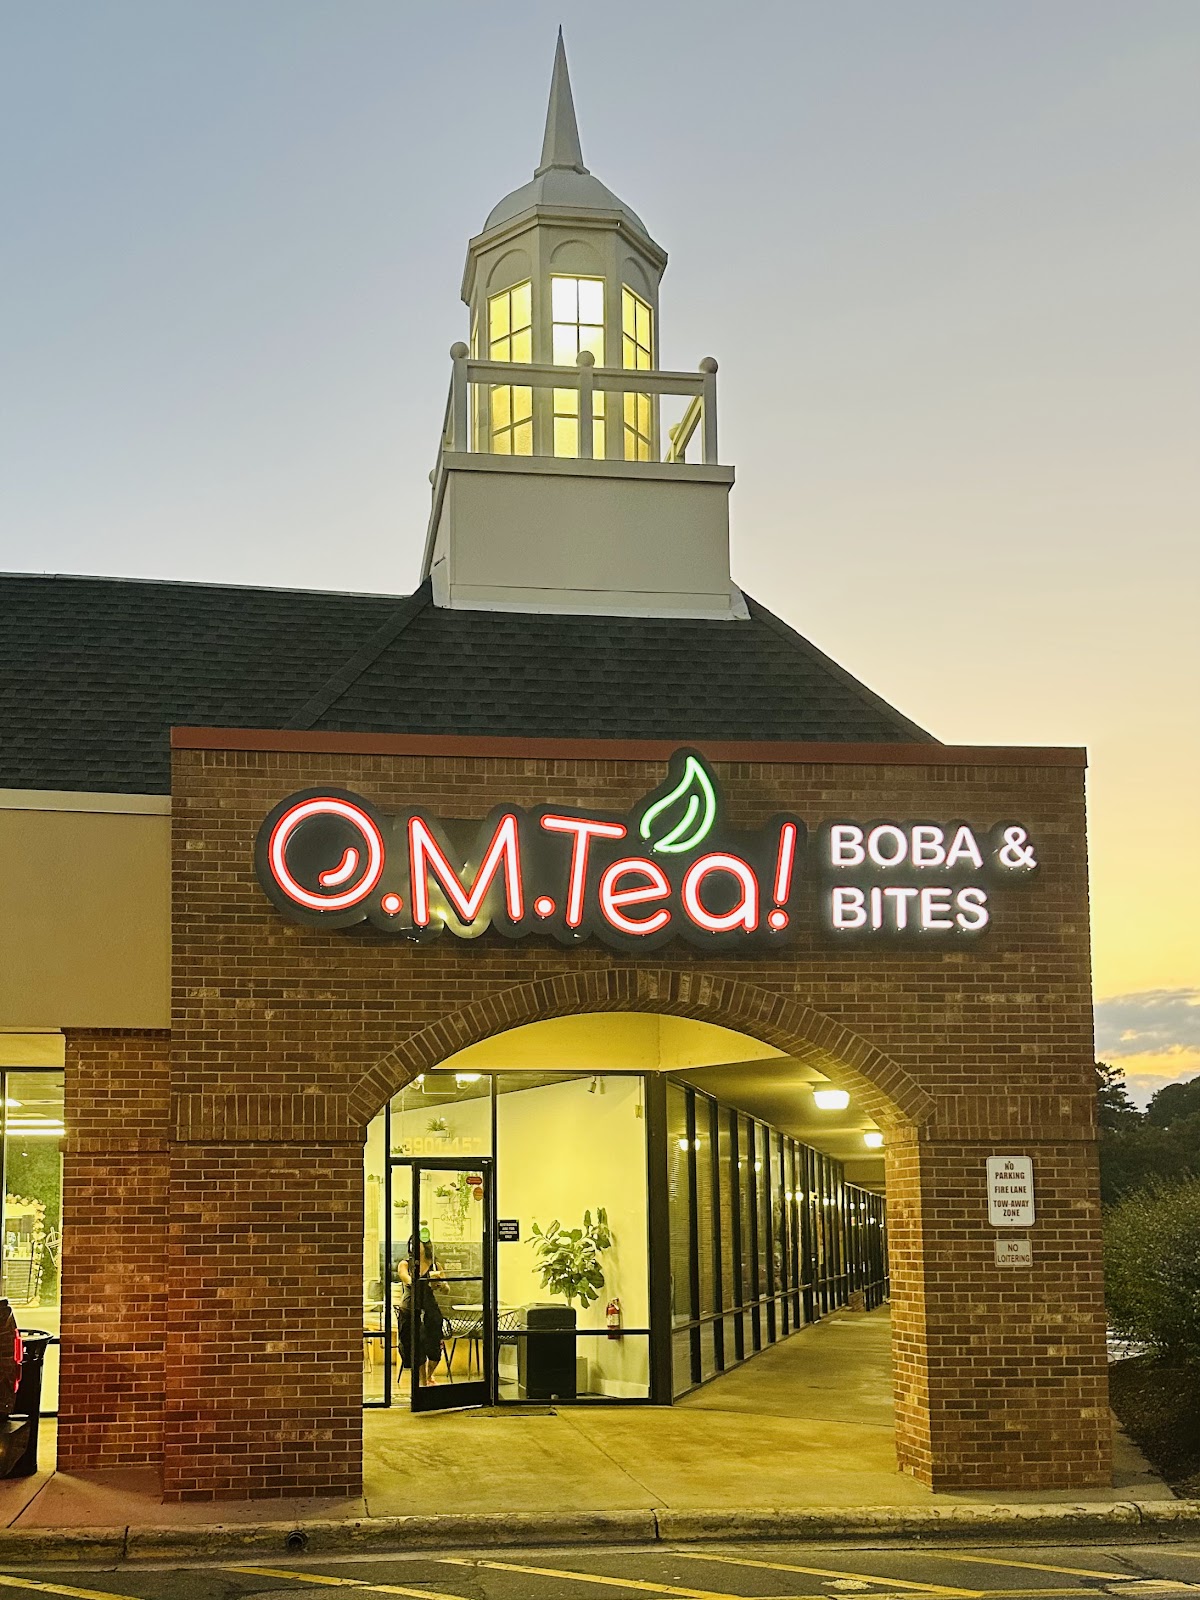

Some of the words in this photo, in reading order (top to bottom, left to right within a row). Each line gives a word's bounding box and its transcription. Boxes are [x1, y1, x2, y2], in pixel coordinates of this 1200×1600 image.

[830, 824, 984, 868] BOBA
[999, 825, 1038, 869] &
[831, 886, 990, 930] BITES
[994, 1172, 1025, 1180] PARKING
